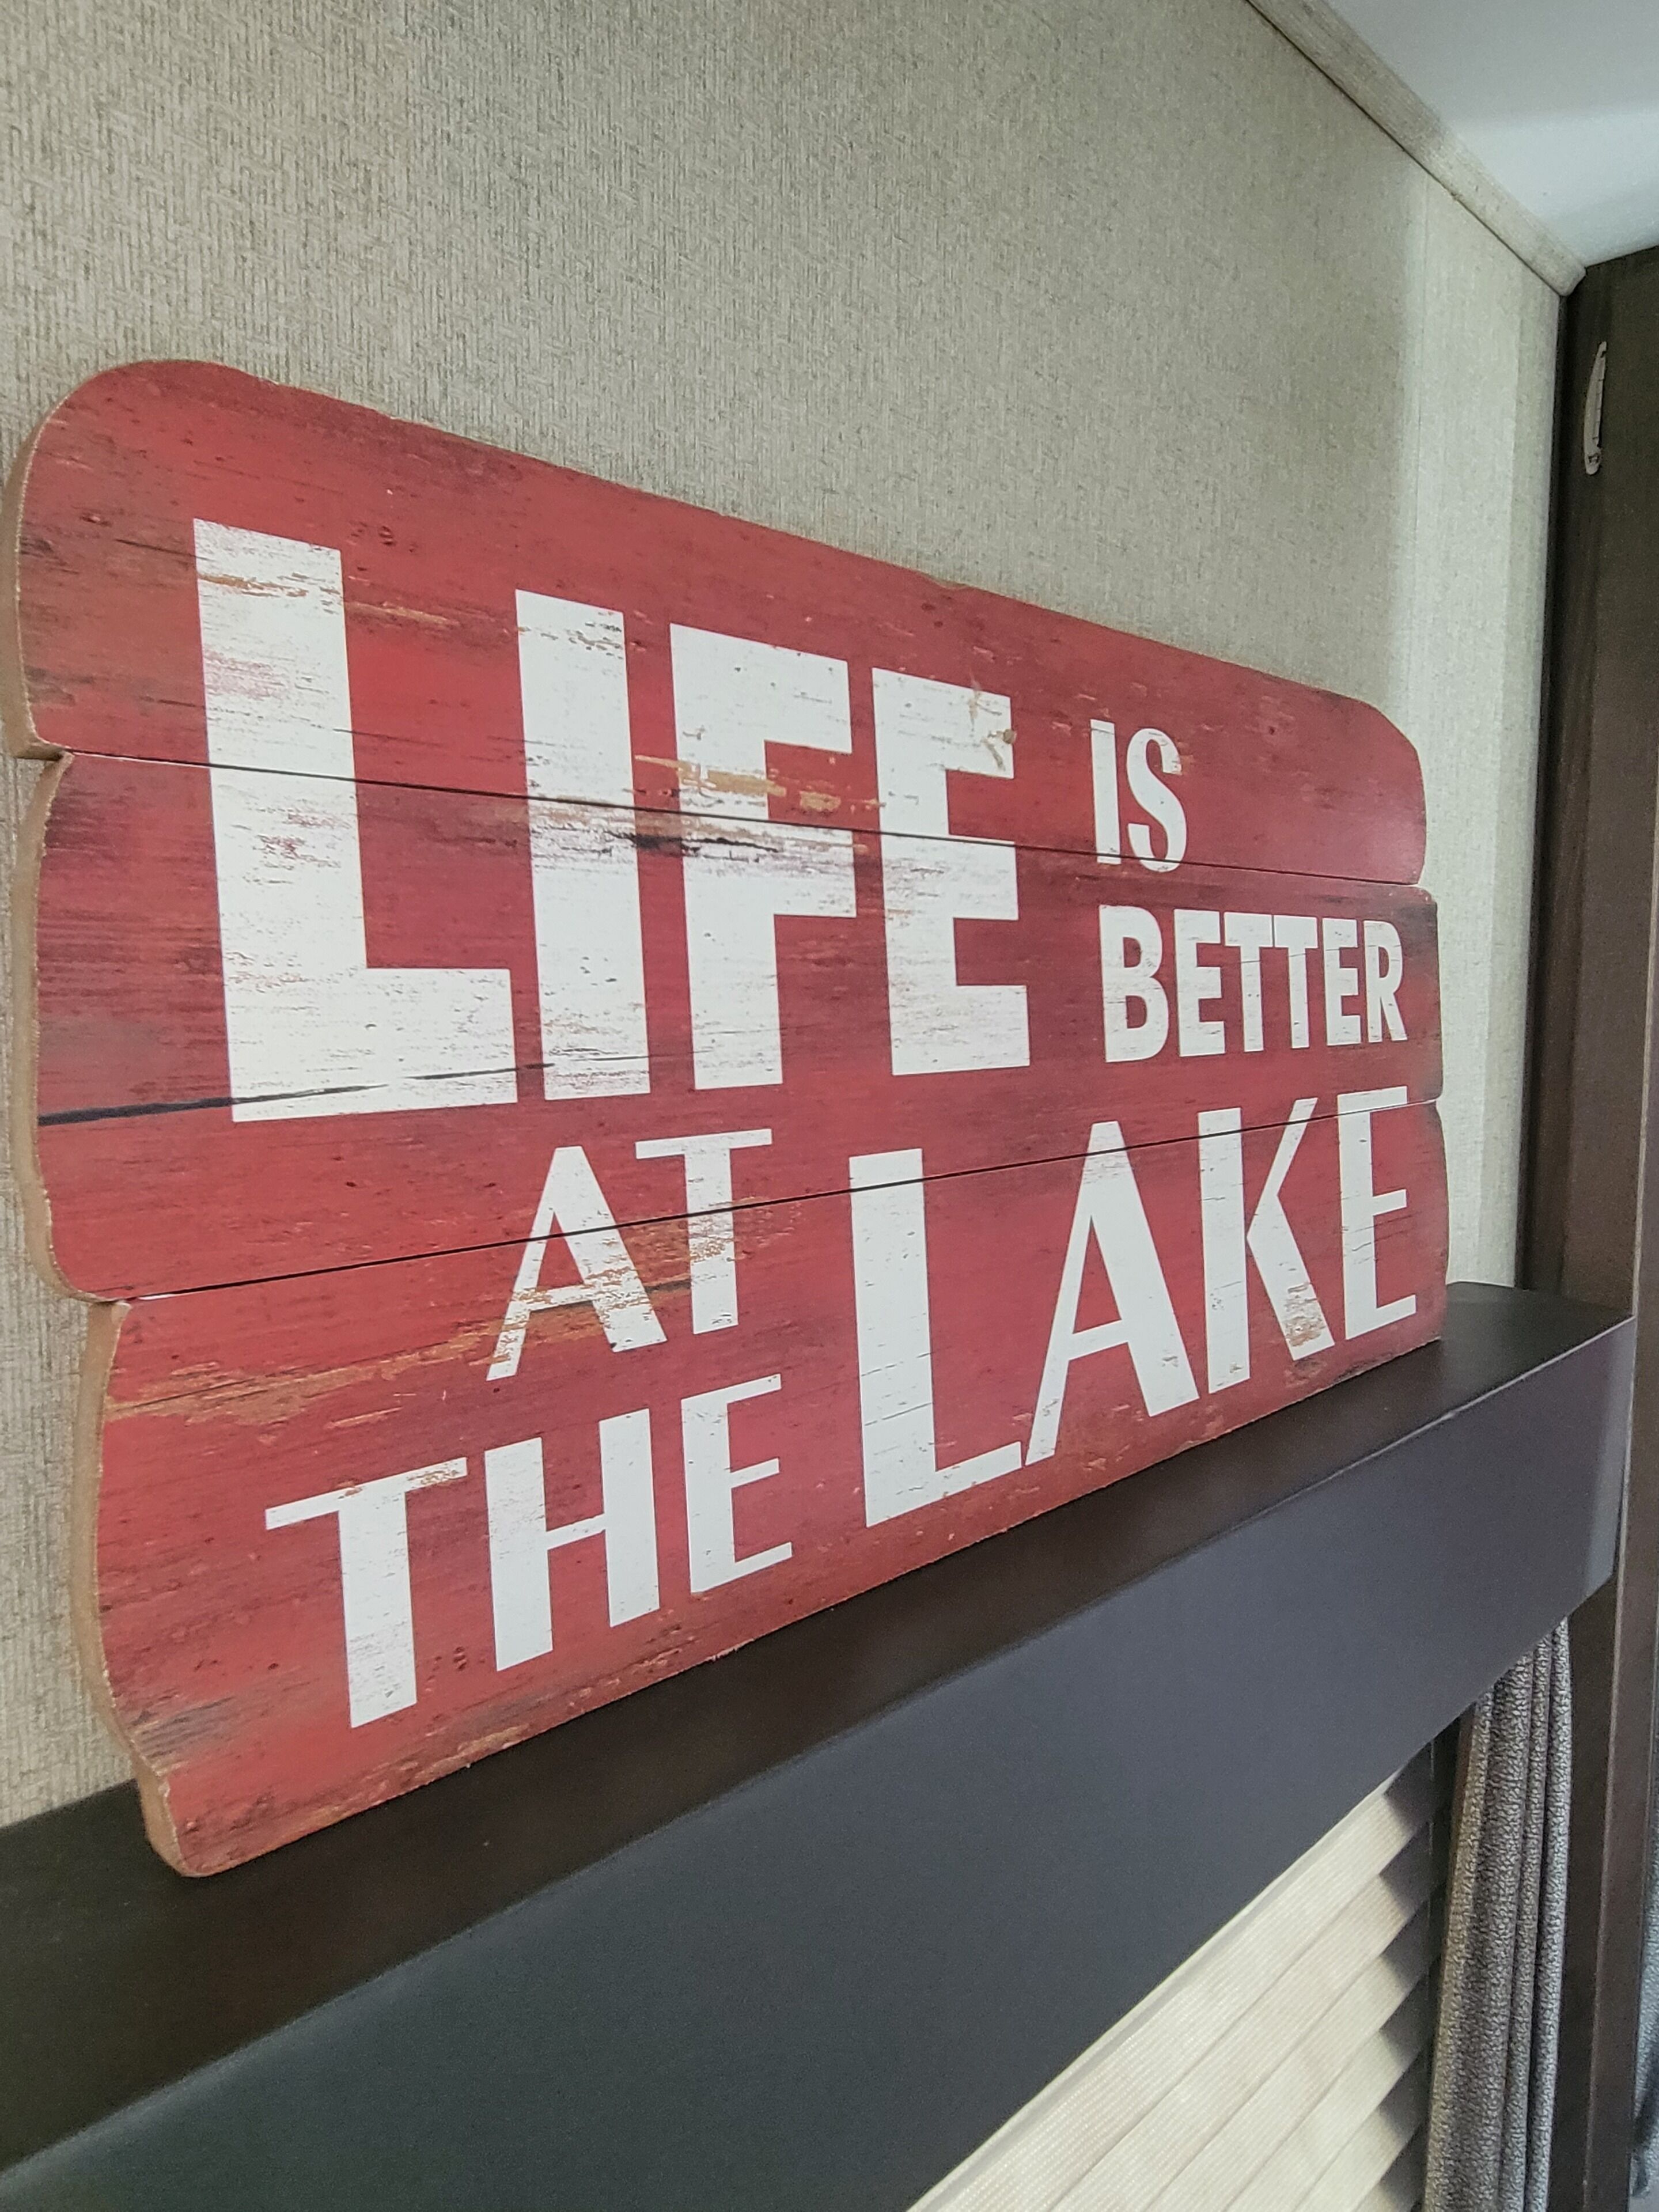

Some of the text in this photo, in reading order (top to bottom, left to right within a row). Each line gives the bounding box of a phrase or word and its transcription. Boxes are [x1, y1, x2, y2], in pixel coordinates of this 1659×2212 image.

[192, 519, 1031, 1123] LIFE
[1090, 719, 1187, 873] IS
[1099, 904, 1408, 1063] BETTER
[486, 1128, 772, 1381] AT
[849, 1086, 1416, 1528] LAKE
[265, 1373, 793, 1728] THE
